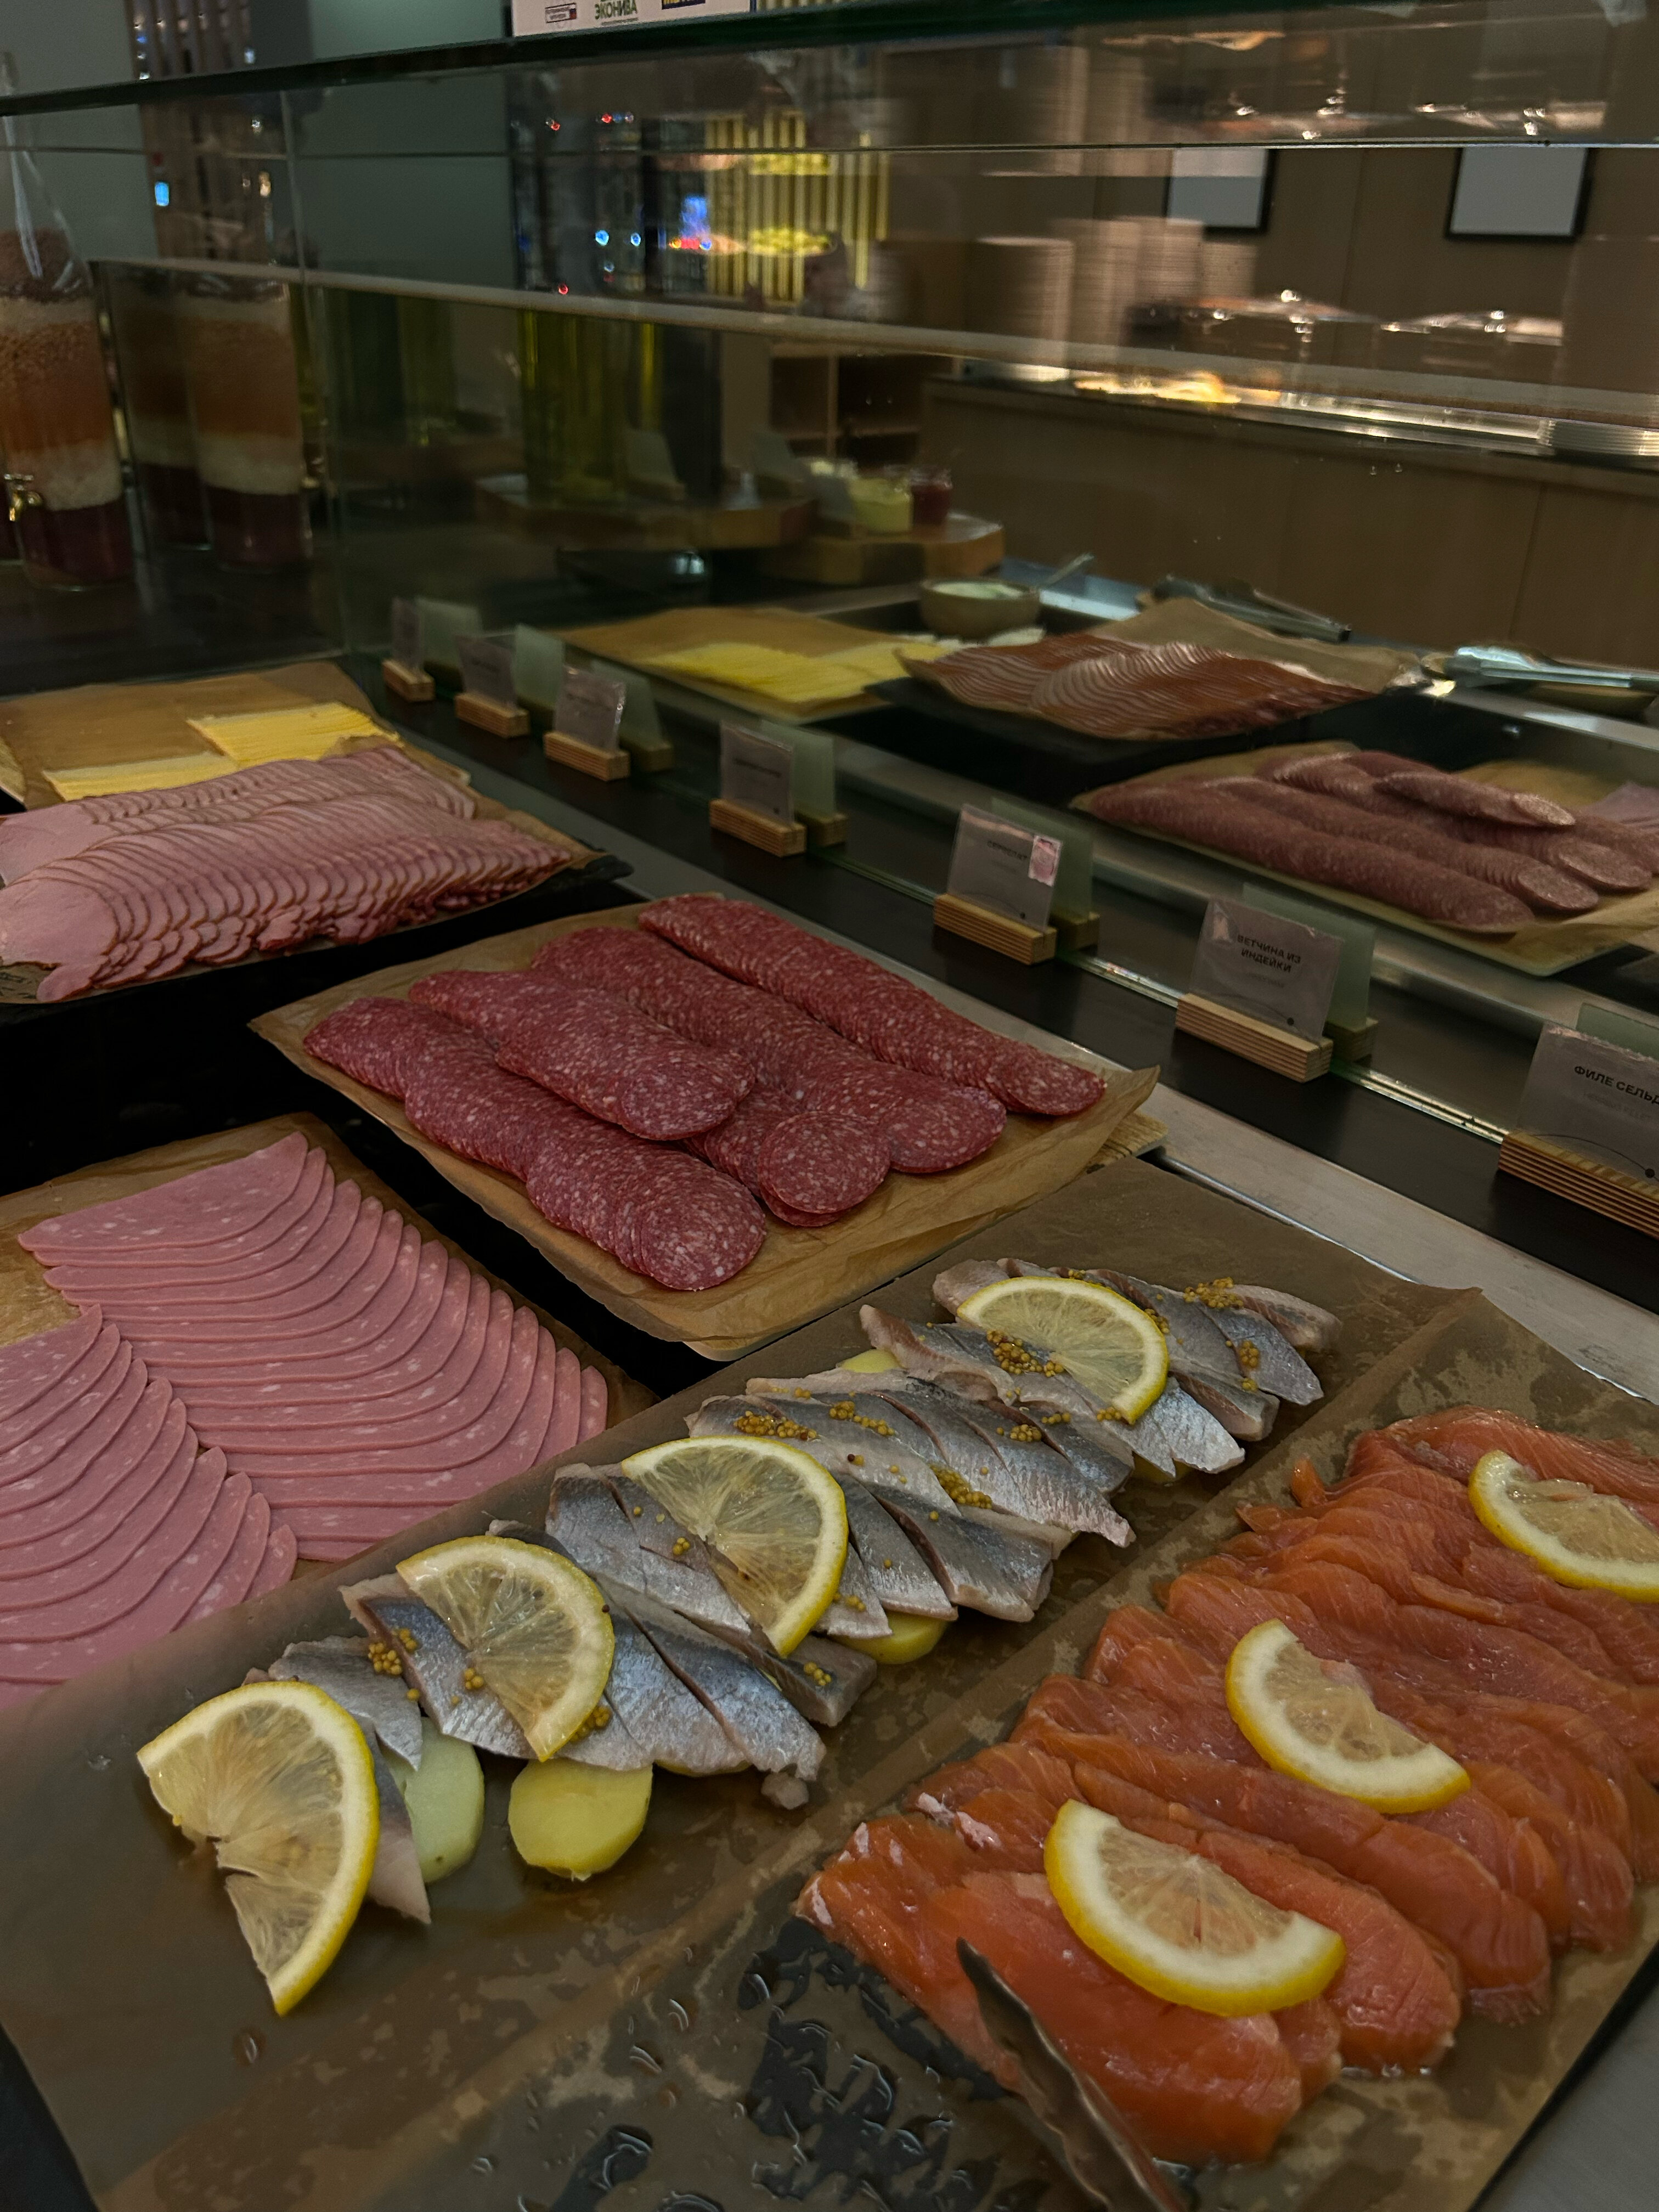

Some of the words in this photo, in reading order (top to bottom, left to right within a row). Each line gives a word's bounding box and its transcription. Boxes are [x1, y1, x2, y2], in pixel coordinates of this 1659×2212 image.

[594, 0, 638, 19] ЭКОНИВА
[1237, 934, 1284, 958] ВЕТЧИНА
[1286, 952, 1301, 964] ИЗ
[1241, 948, 1292, 973] ИНДЕЙКИ
[1574, 1066, 1615, 1087] ФИЛЕ
